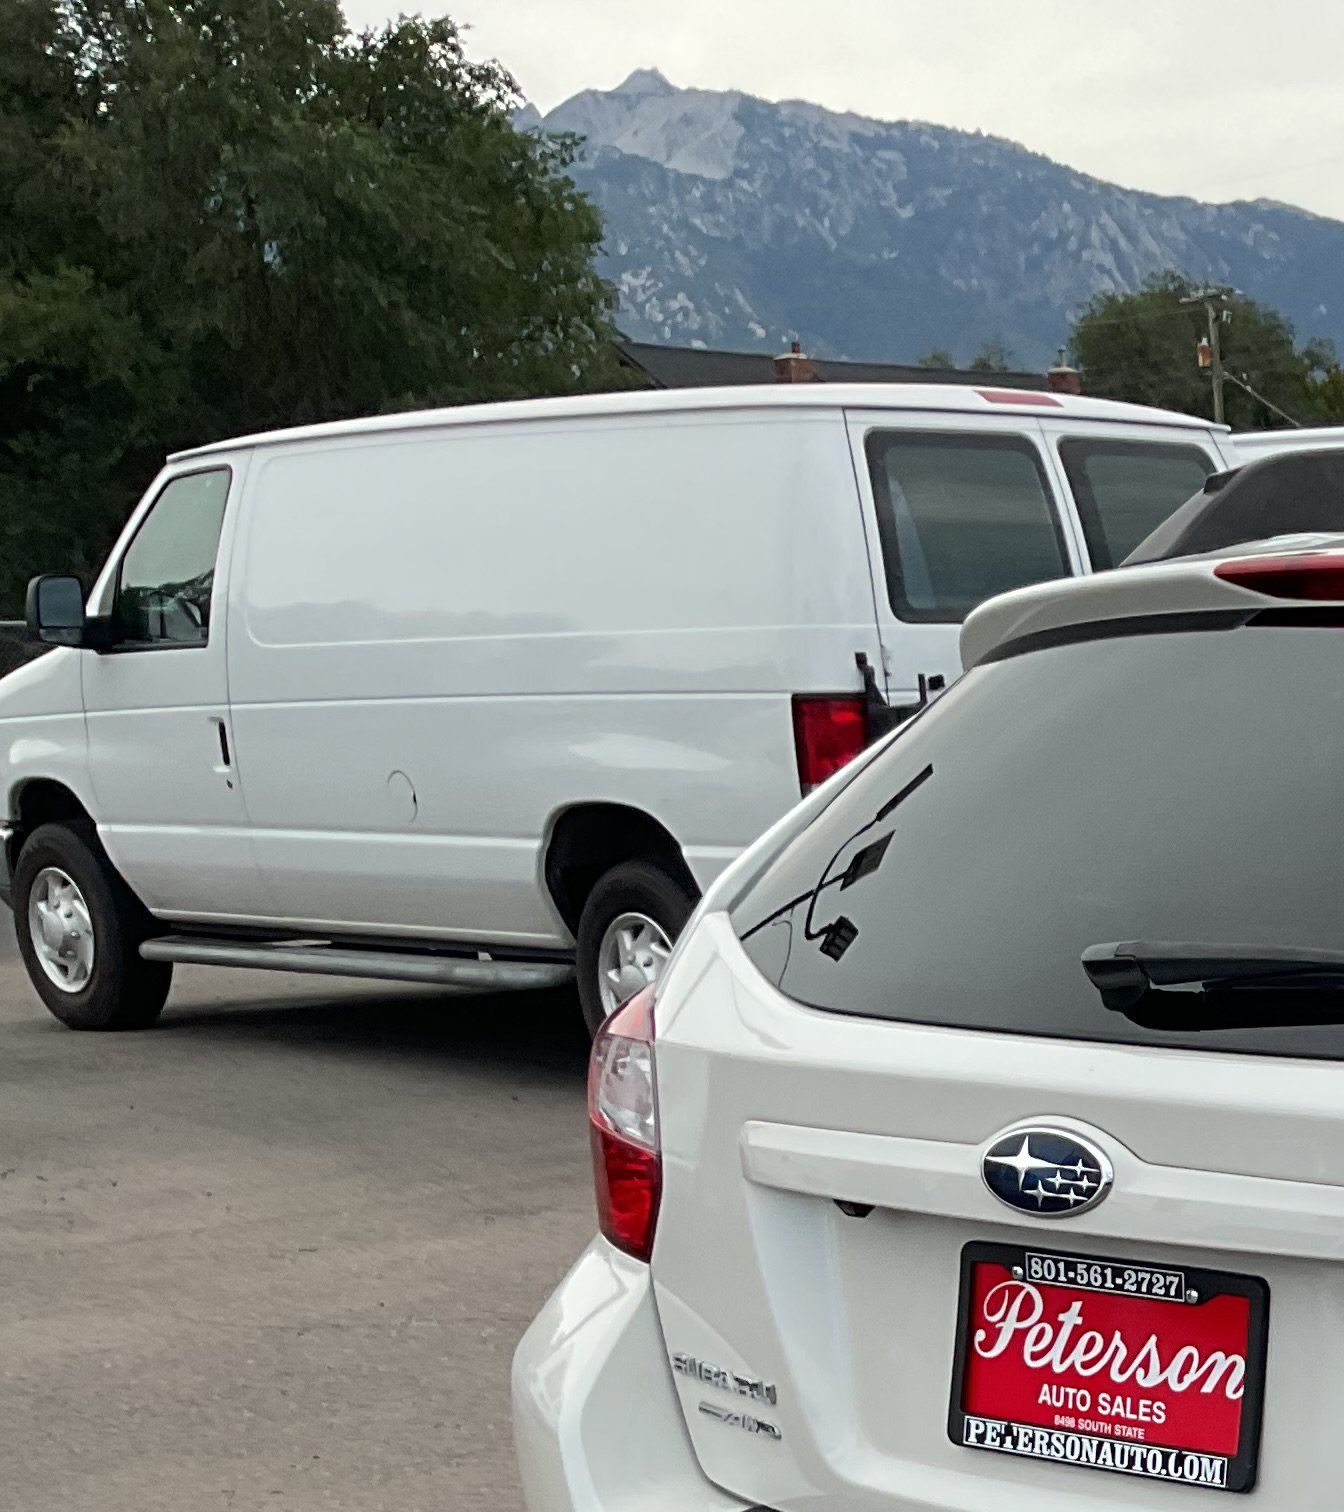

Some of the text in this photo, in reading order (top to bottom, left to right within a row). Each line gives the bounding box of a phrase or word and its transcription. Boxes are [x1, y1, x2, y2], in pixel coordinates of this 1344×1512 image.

[1030, 1258, 1180, 1297] 801-561-2727
[974, 1280, 1246, 1400] Peterson
[1038, 1384, 1167, 1424] AUTO SALES
[1078, 1418, 1112, 1435] SOUTH
[1114, 1424, 1145, 1439] STATE
